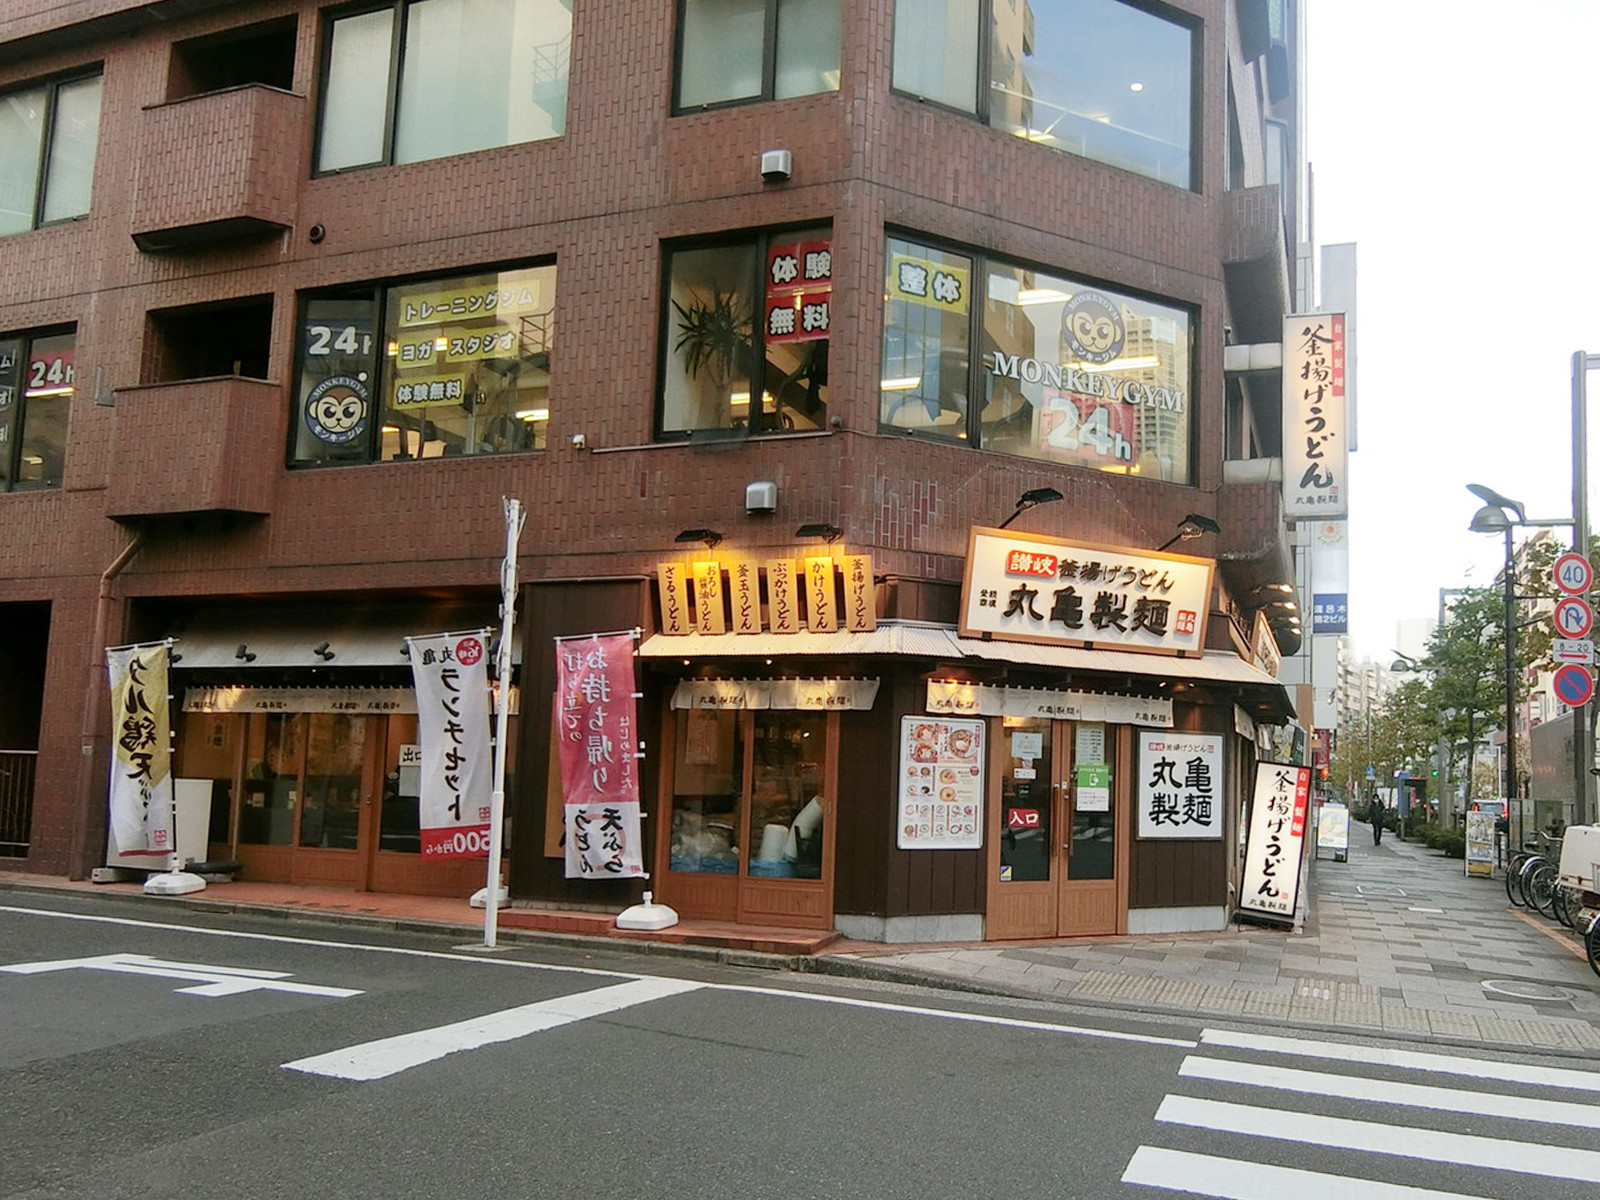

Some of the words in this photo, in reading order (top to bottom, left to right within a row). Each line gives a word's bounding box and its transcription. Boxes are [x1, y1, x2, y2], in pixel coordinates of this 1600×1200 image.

[771, 251, 832, 284] 体験
[898, 262, 961, 304] 整体
[405, 288, 534, 322] トレーニングジム
[769, 302, 830, 335] 無料
[401, 340, 434, 362] ヨガ
[449, 331, 516, 357] スタジオ
[313, 376, 369, 399] MONKEYGYM
[396, 379, 463, 405] 体験無料
[992, 350, 1184, 415] MONKEYGYM
[1296, 324, 1336, 489] 釜揚げうどん
[1047, 396, 1132, 461] 24h
[706, 564, 719, 599] おろし
[1009, 551, 1056, 577] 讃岐
[1057, 558, 1175, 593] 釜揚げうどん
[1562, 565, 1585, 584] 40
[664, 566, 682, 633] ざるうどん
[736, 563, 753, 631] 釜玉うどん
[773, 562, 791, 630] ぶっかけうどん
[811, 562, 829, 630] かけうどん
[851, 558, 868, 629] 釜揚げうどん
[1003, 582, 1172, 637] 丸亀製麺
[402, 747, 422, 763] 出口
[1148, 756, 1213, 793] 丸亀
[1009, 811, 1040, 826] 入口
[1148, 792, 1213, 827] 製麺
[1257, 769, 1296, 898] 釜揚げうどん
[1249, 898, 1288, 913] 丸亀製麺
